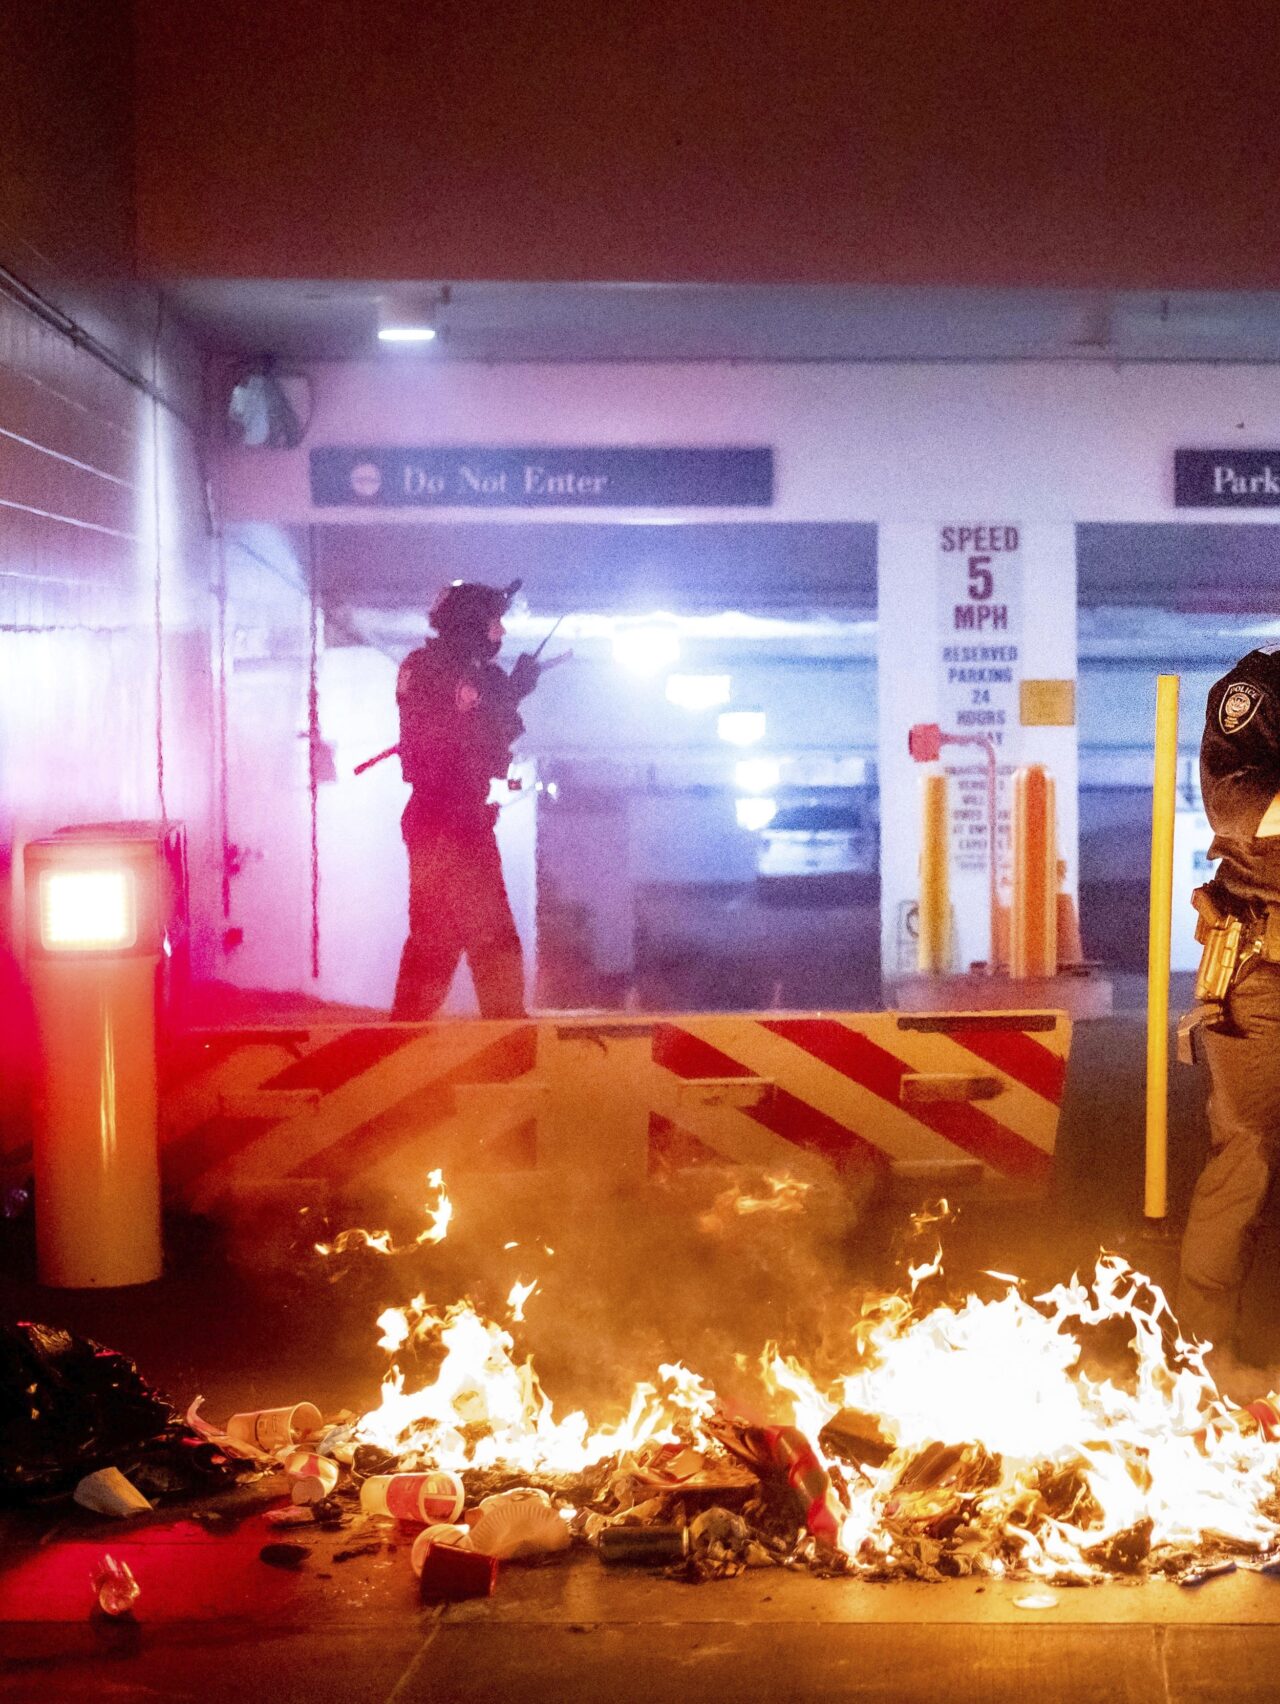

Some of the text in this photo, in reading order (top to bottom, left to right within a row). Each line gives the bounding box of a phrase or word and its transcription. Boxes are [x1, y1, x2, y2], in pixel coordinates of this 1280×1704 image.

[403, 465, 609, 494] Do Not Enter
[941, 526, 1019, 552] SPEED
[967, 555, 994, 601] 5
[953, 604, 1008, 630] MPH
[942, 646, 1018, 662] RESERVED
[948, 668, 1012, 683] PARKING
[1230, 685, 1257, 700] POLICE
